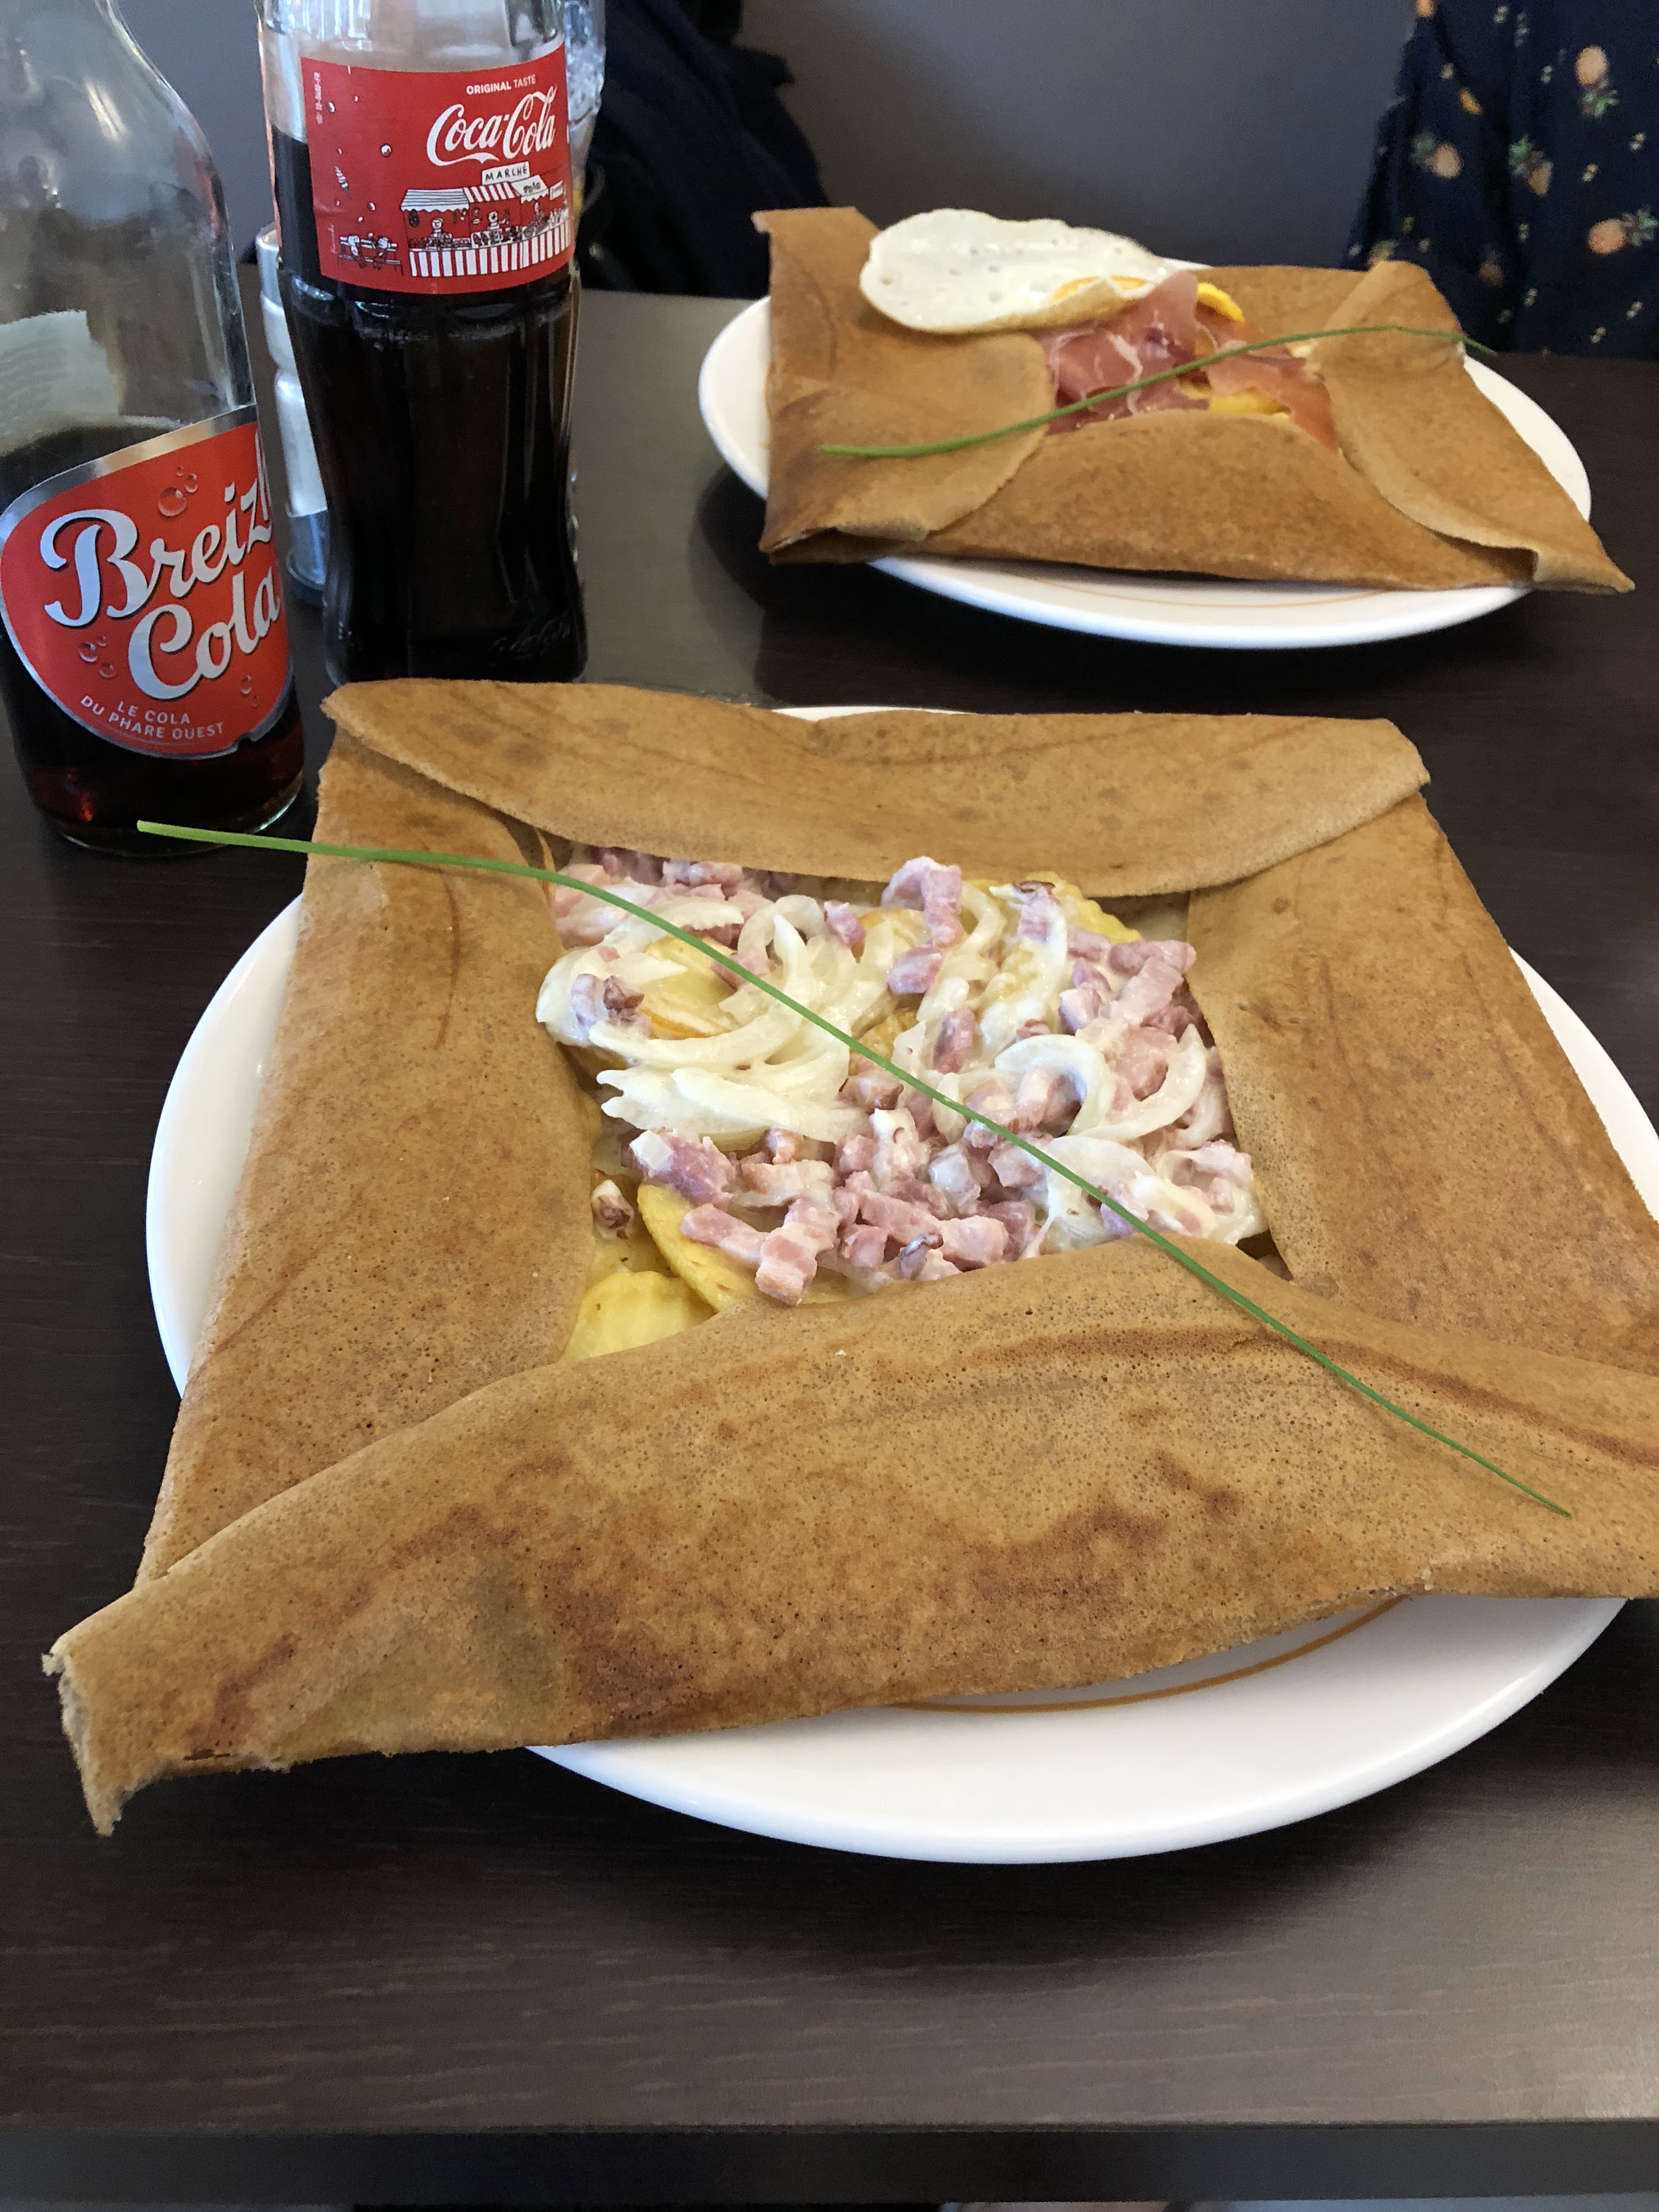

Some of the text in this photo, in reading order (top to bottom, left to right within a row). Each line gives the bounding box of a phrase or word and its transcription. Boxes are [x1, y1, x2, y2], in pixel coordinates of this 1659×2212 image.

[466, 74, 536, 95] ORIGINAL TASTE
[427, 84, 557, 166] Coca-Cola
[128, 569, 280, 700] Cola
[81, 695, 224, 740] DU PHARE OUEST
[117, 701, 190, 724] LE COLA
